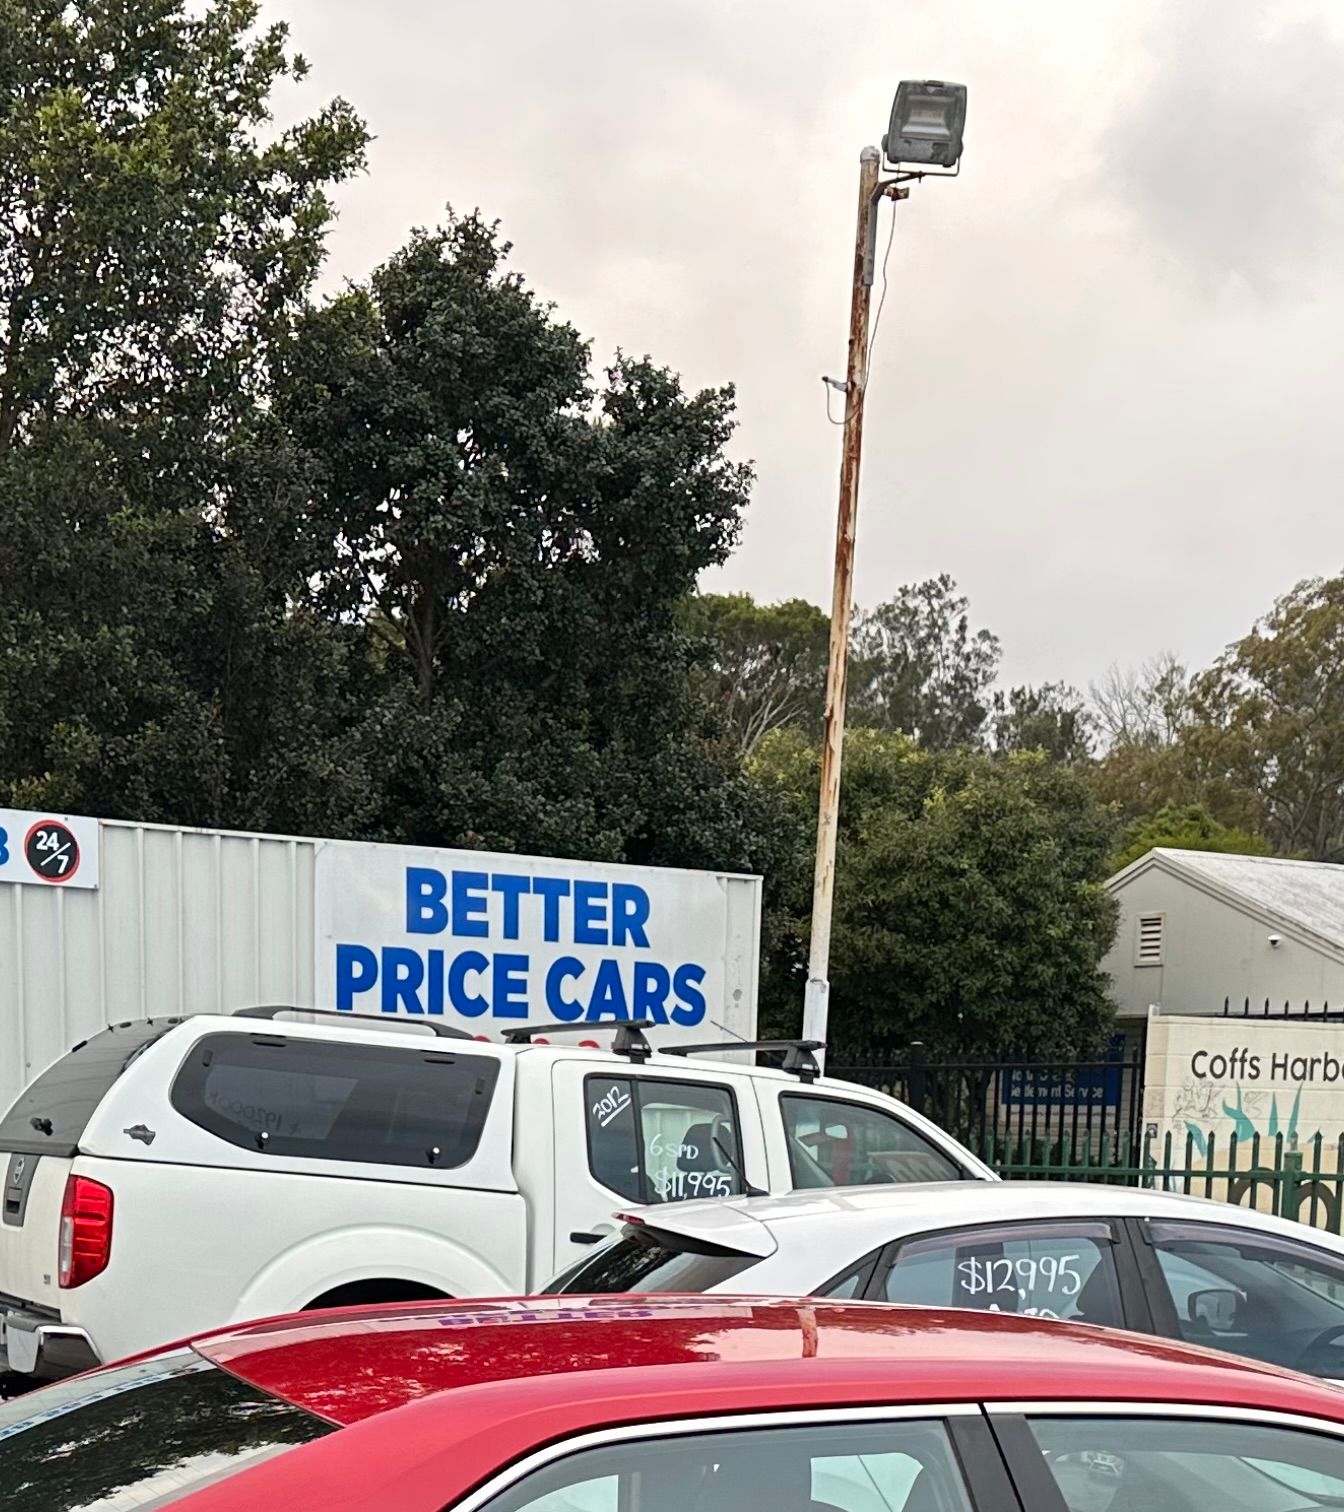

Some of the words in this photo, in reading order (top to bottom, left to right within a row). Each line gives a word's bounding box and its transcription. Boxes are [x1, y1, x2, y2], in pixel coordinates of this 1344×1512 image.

[36, 830, 71, 874] 24/7
[405, 866, 651, 949] BETTER
[335, 943, 530, 1020] PRICE
[544, 955, 707, 1028] CARS
[1191, 1047, 1261, 1080] Coffs
[592, 1086, 630, 1121] 2012
[650, 1133, 663, 1157] 6
[957, 1256, 1082, 1301] $12,995
